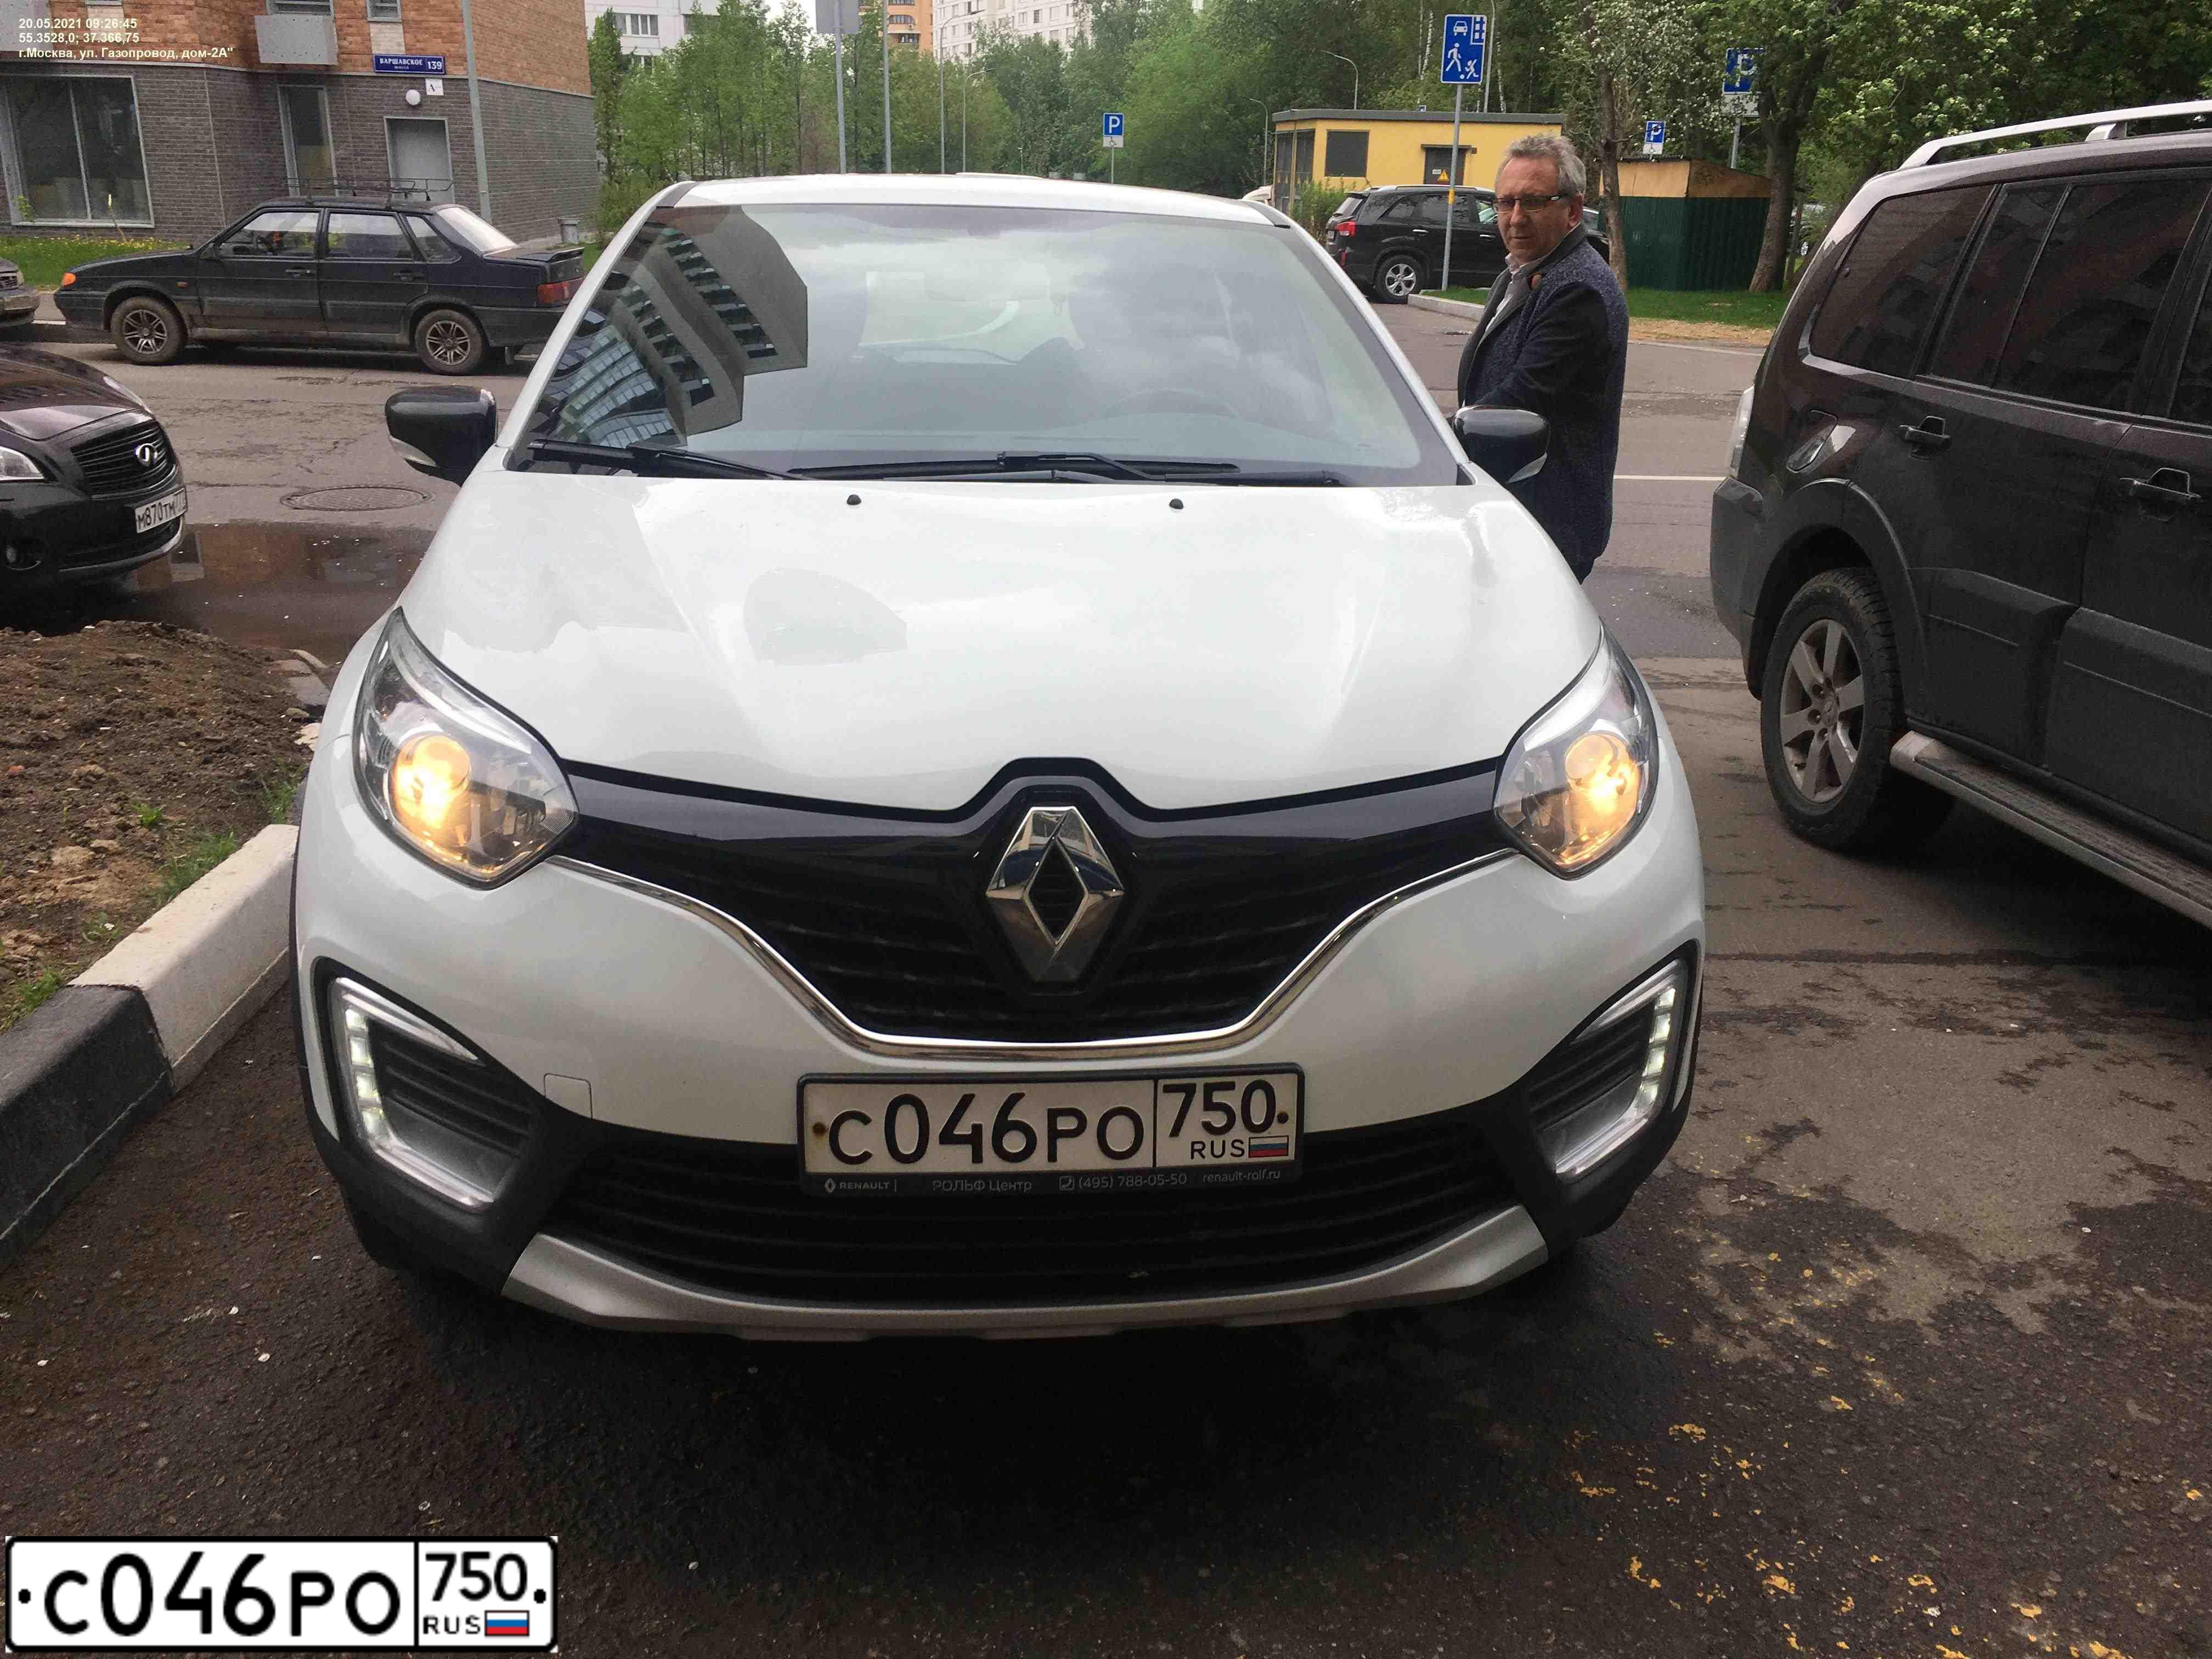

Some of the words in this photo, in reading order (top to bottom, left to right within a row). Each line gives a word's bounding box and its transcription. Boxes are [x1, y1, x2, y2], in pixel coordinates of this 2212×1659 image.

[427, 61, 442, 70] 139
[1163, 1080, 1276, 1137] 750
[1190, 1139, 1245, 1159] RUS
[1079, 1178, 1114, 1190] (495)
[1118, 1173, 1187, 1186] 788-05-50
[1203, 1169, 1281, 1183] renault-rolf.ru
[839, 1181, 891, 1190] RENAULT
[933, 1180, 985, 1192] РОЛЬФ
[989, 1180, 1032, 1193] Центр
